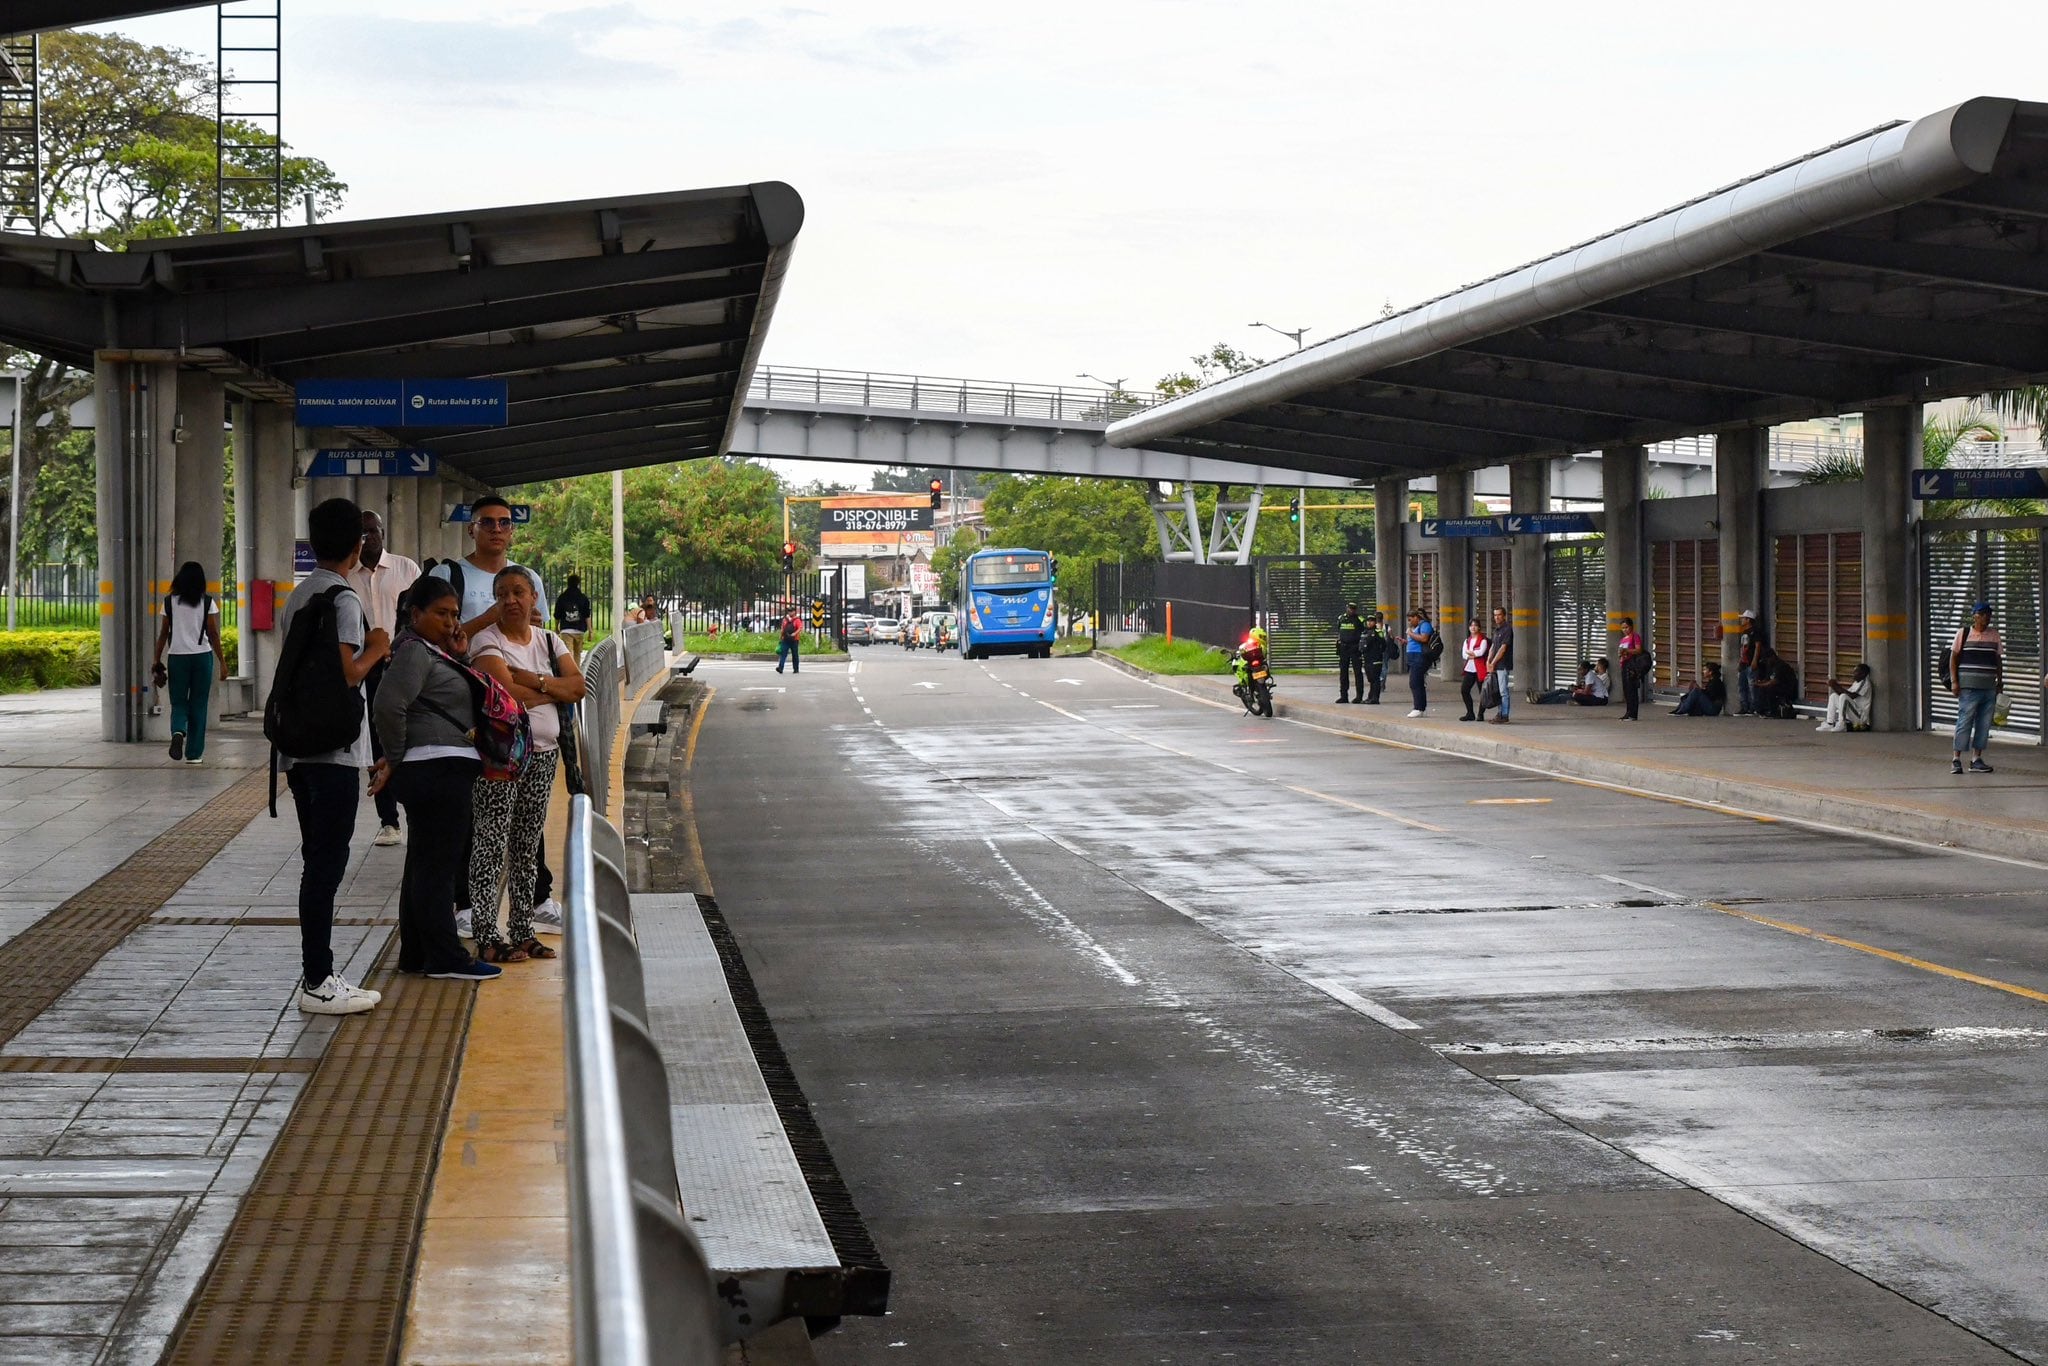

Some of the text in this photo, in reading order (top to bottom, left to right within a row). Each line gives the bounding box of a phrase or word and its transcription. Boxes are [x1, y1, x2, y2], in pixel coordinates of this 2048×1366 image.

[298, 398, 336, 406] TERMINAL
[1953, 471, 1981, 479] RUTAS
[833, 509, 919, 522] DISPONIBLE
[845, 521, 907, 530] 318-676-8979
